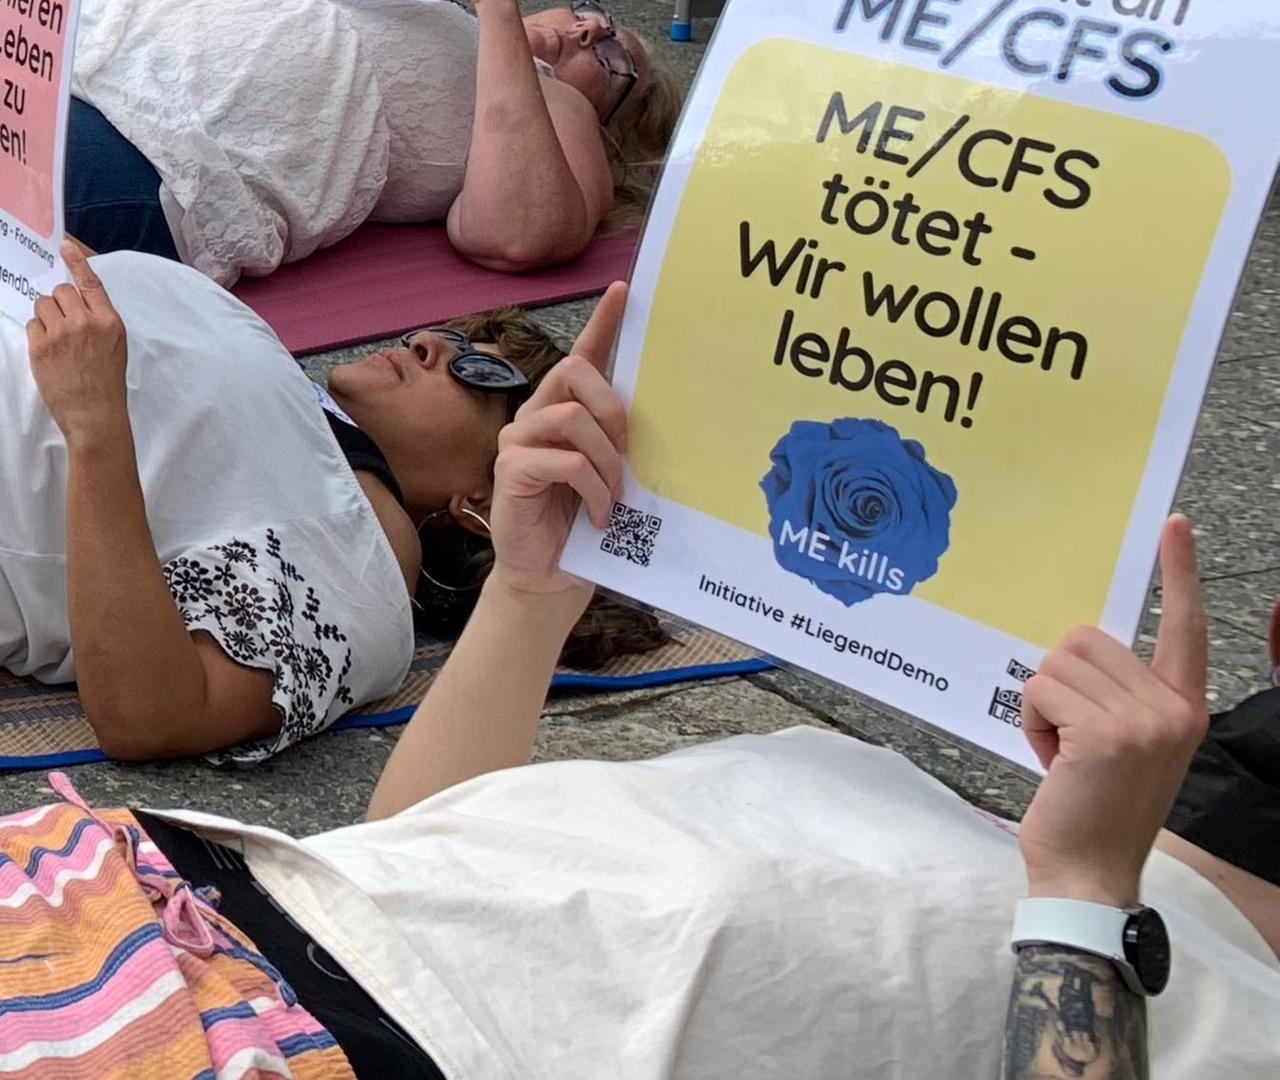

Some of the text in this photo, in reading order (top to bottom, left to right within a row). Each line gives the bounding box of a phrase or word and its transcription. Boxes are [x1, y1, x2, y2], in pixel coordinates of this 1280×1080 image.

[4, 78, 25, 115] zu
[815, 91, 1100, 209] ME/CFS
[14, 227, 54, 268] Forschung
[822, 173, 993, 266] tötet
[739, 221, 1088, 381] Wir wollen
[773, 309, 984, 428] leben!
[779, 518, 906, 592] ME kills
[698, 574, 950, 693] Initiative #LiegendDemo
